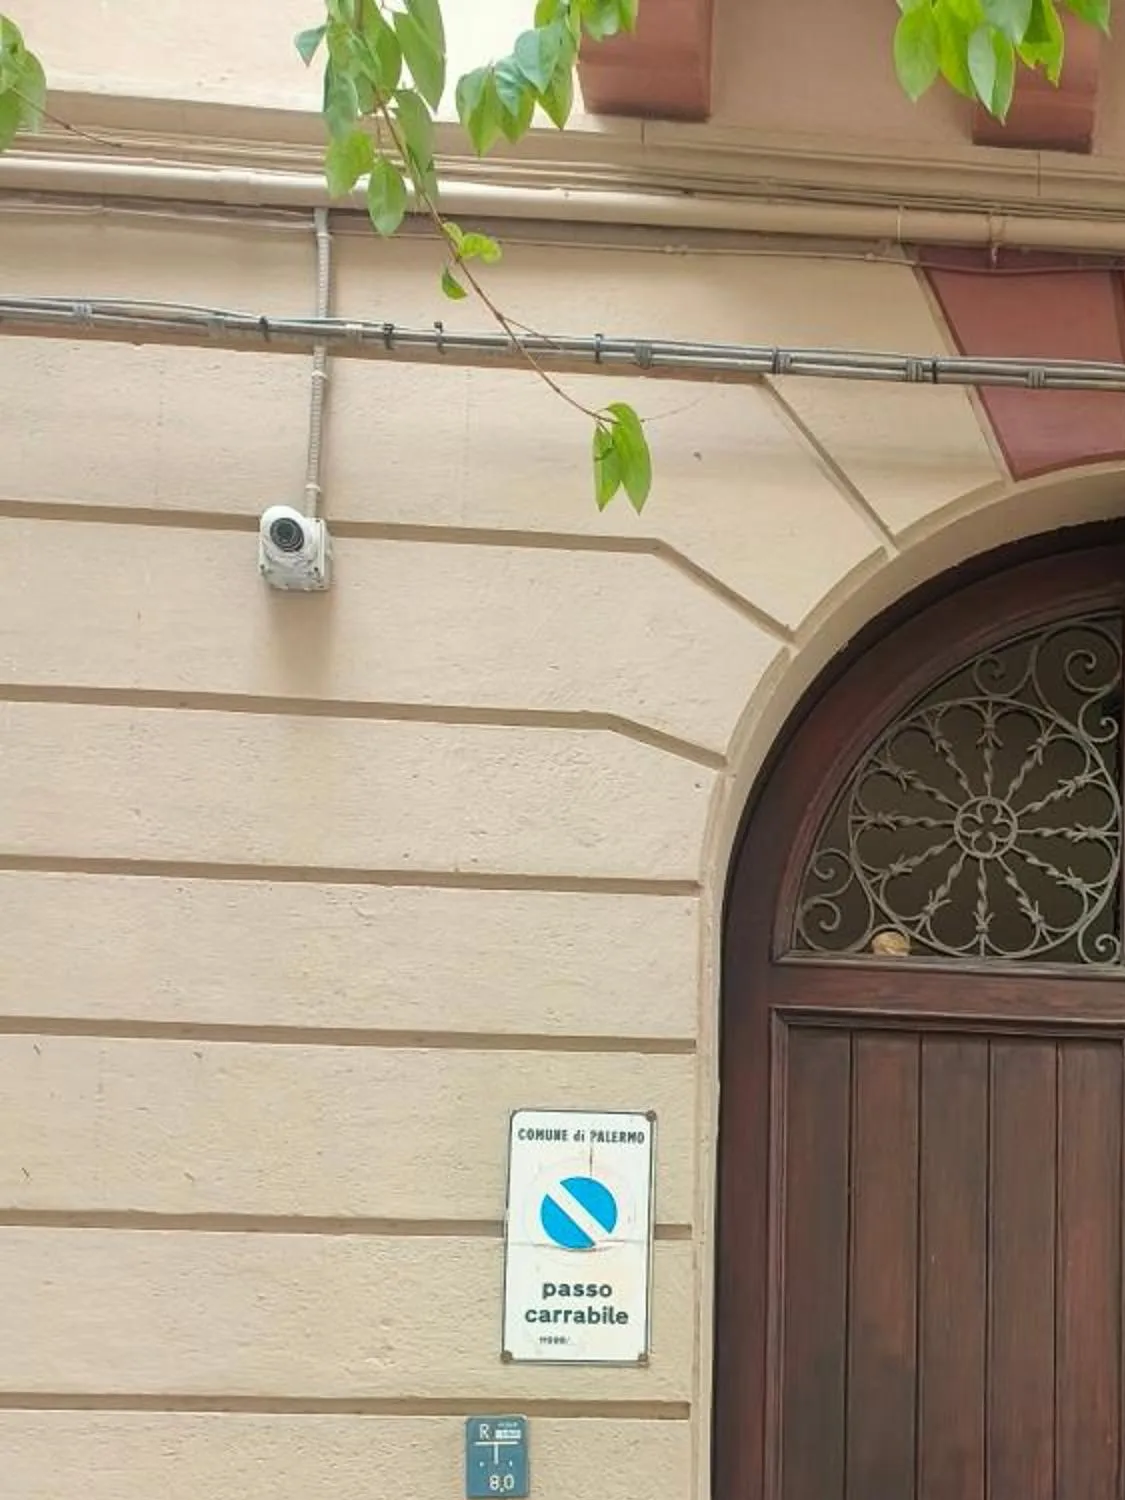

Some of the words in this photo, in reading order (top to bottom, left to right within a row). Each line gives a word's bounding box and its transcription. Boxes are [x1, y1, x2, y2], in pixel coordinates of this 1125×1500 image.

[517, 1127, 569, 1142] COMUNE
[573, 1129, 585, 1143] di
[589, 1129, 646, 1145] PALERMO
[541, 1281, 613, 1300] passo
[524, 1306, 630, 1325] carrabile
